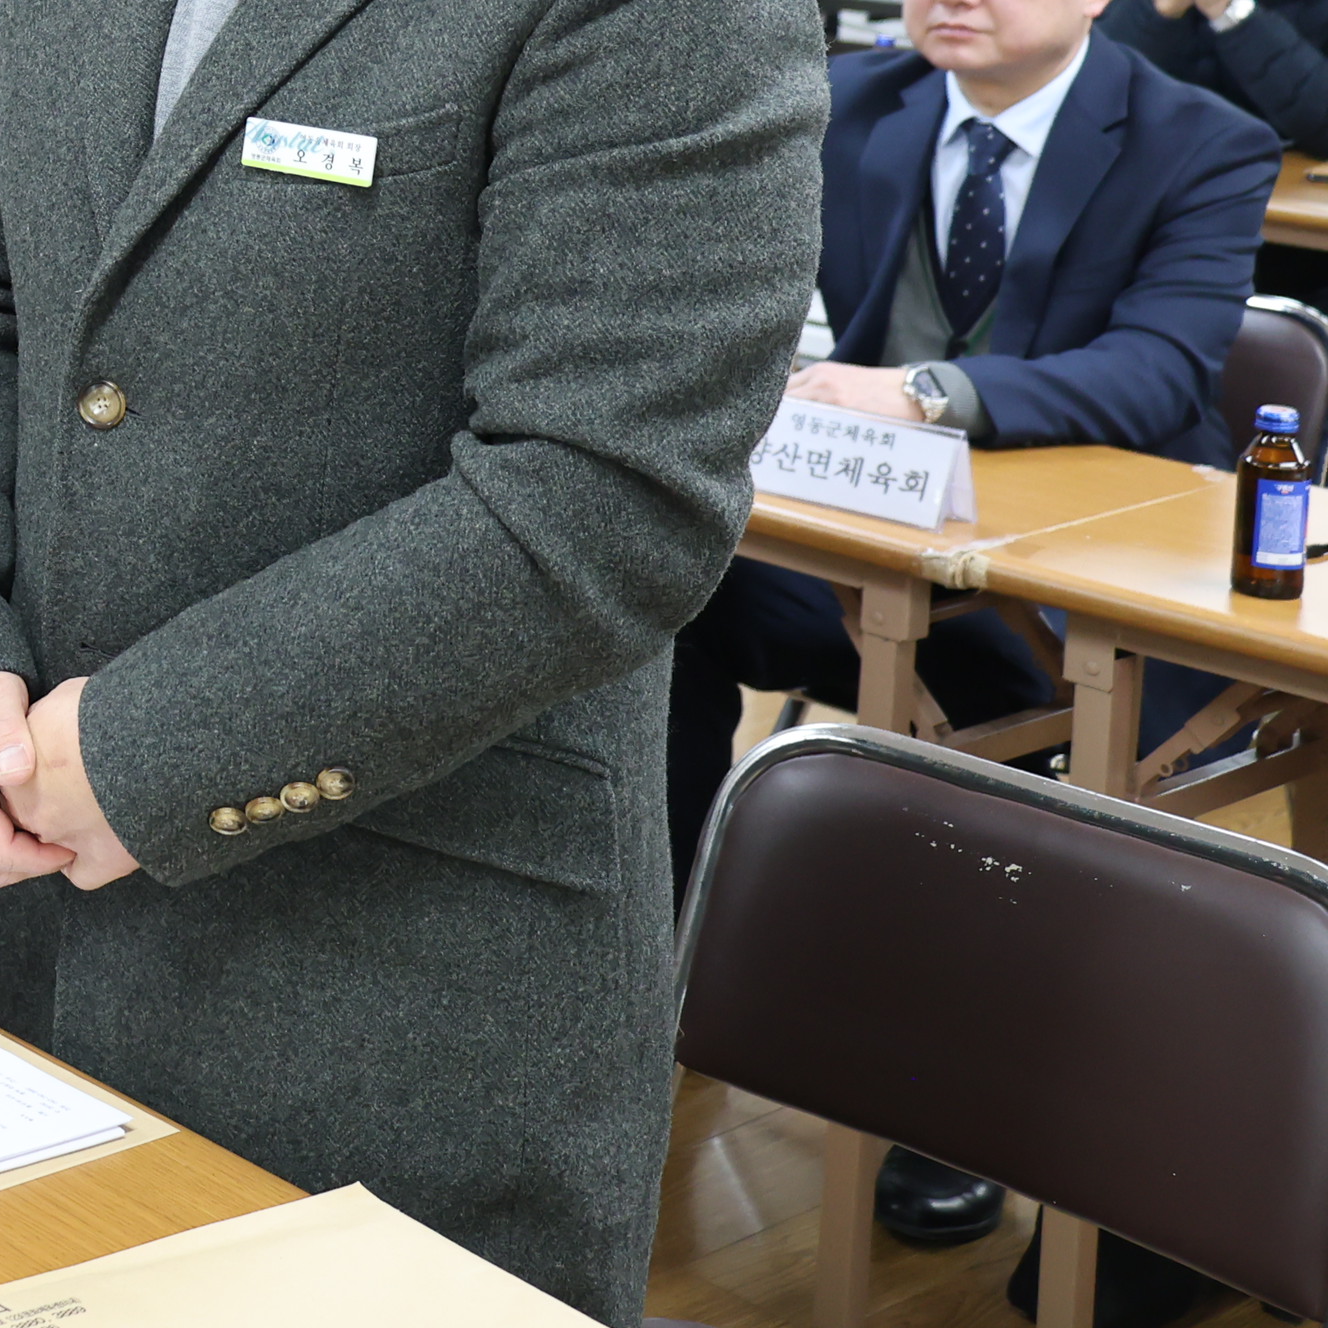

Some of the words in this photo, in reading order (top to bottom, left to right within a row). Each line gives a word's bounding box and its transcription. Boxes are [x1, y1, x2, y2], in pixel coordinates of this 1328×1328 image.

[293, 149, 308, 164] 오
[321, 152, 335, 171] 경
[348, 157, 364, 175] 복
[791, 412, 896, 452] 영동군체육회
